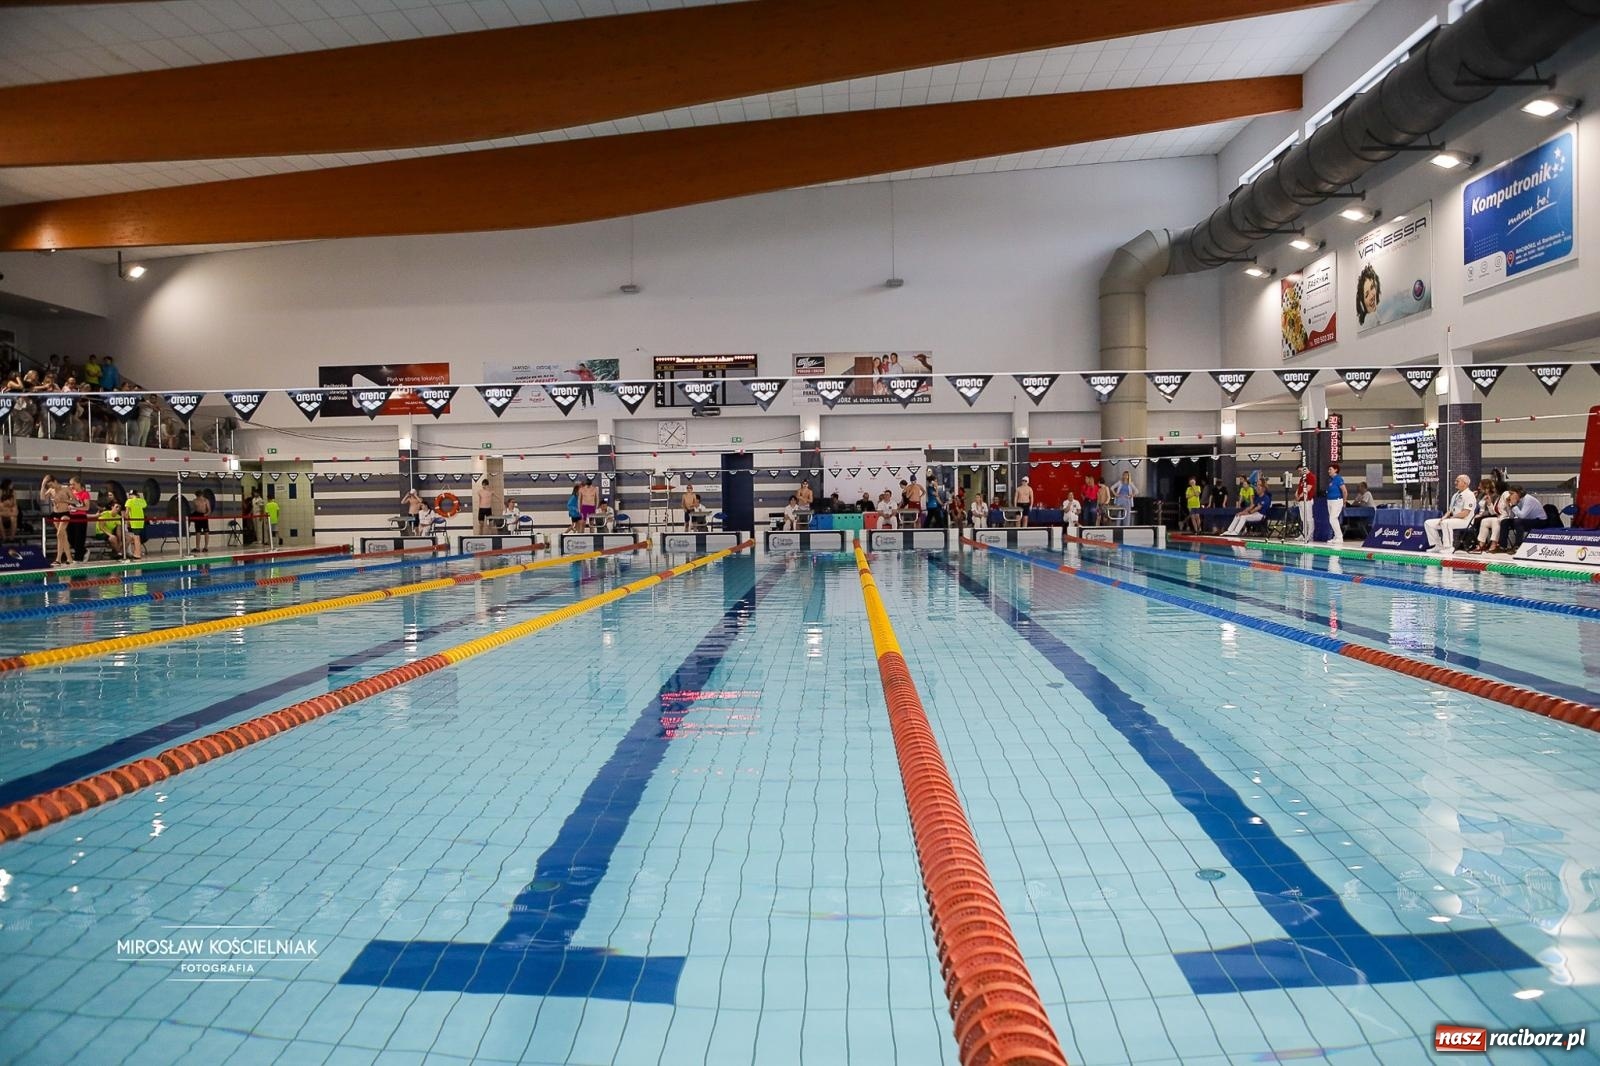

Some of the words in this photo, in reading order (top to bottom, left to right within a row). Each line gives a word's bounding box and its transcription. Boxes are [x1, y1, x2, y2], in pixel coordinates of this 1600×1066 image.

[1471, 162, 1552, 215] Komputronik
[1508, 206, 1533, 226] mamy
[1536, 187, 1550, 209] to!
[1359, 216, 1426, 259] VANESSA
[1346, 372, 1370, 380] arena
[1407, 370, 1432, 379] arena
[1472, 368, 1496, 377] arena
[1538, 367, 1562, 376] arena
[1023, 377, 1049, 386] arena
[1091, 376, 1117, 384] arena
[1155, 375, 1181, 384] arena
[1219, 374, 1244, 382] arena
[1284, 373, 1308, 382] arena
[751, 382, 778, 391] arena
[817, 381, 844, 390] arena
[890, 380, 917, 388] arena
[956, 378, 983, 387] arena
[486, 388, 512, 397] arena
[552, 386, 578, 395] arena
[618, 385, 645, 394] arena
[685, 384, 712, 392] arena
[232, 394, 258, 403] arena
[296, 393, 322, 402] arena
[360, 391, 386, 400] arena
[423, 390, 449, 398] arena
[47, 397, 72, 406] arena
[110, 396, 135, 405] arena
[171, 395, 197, 404] arena
